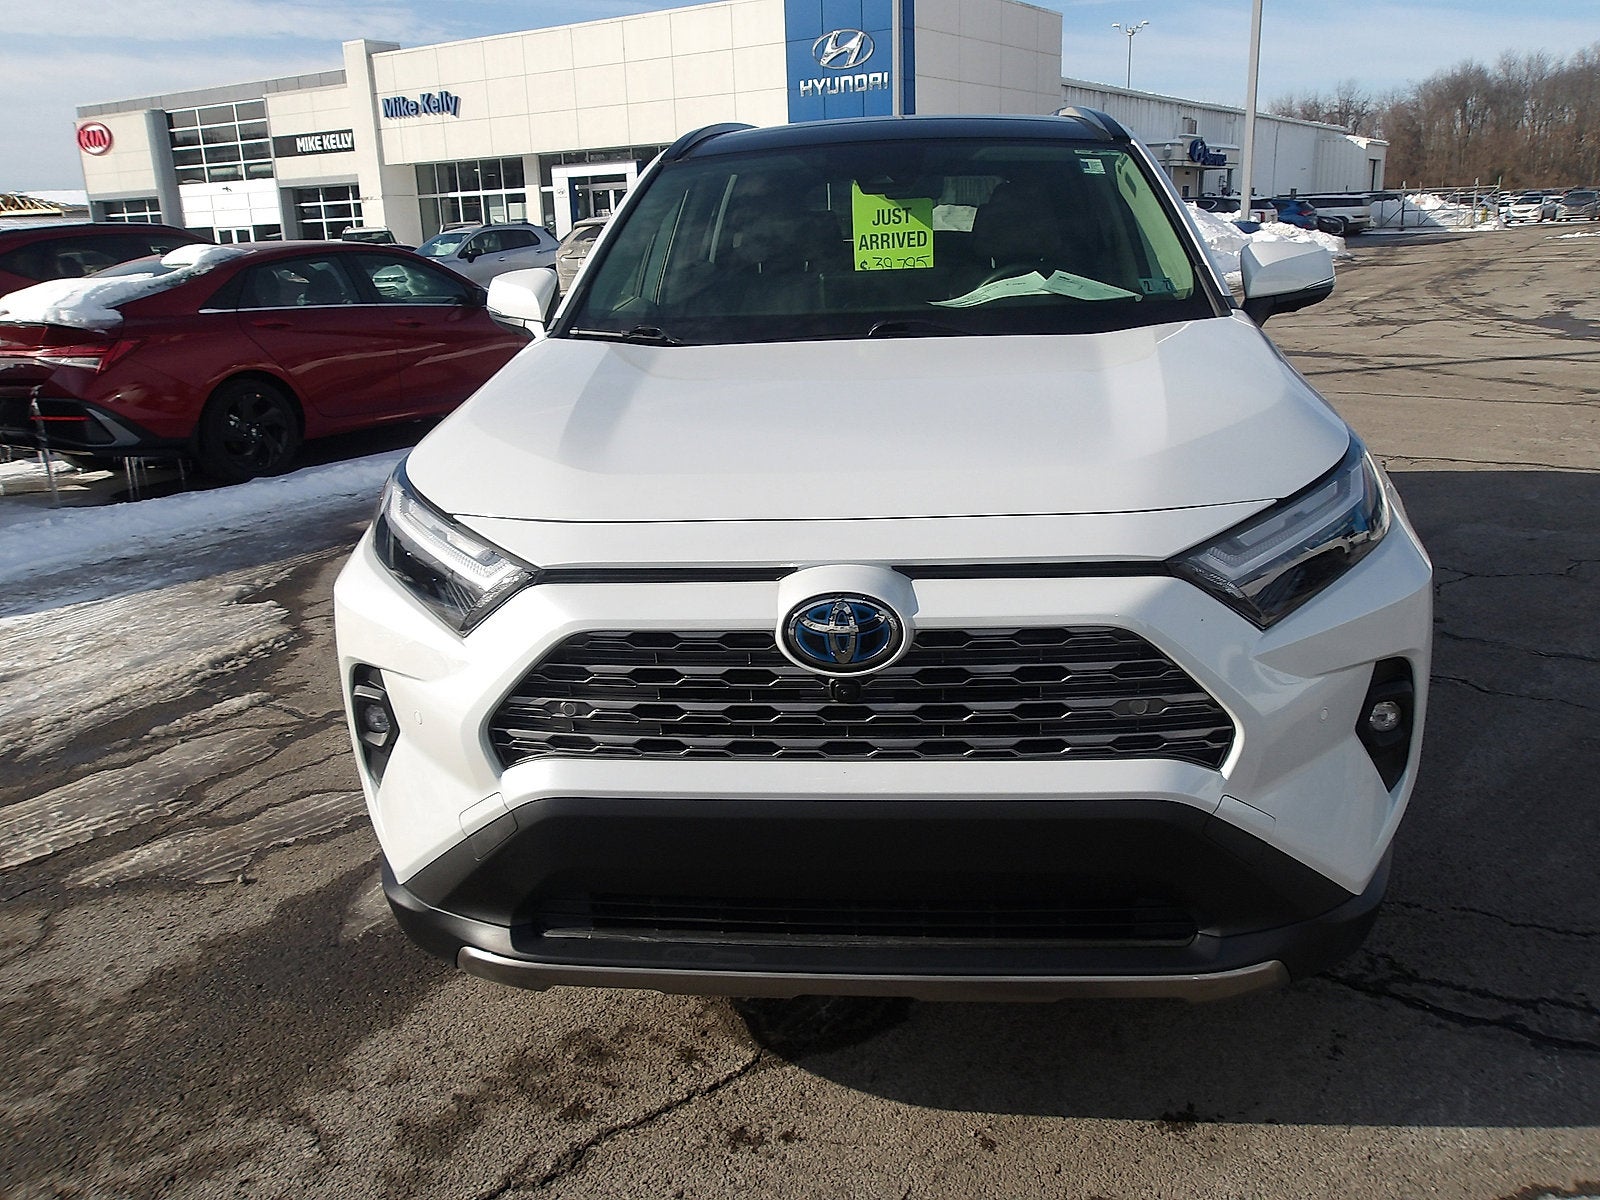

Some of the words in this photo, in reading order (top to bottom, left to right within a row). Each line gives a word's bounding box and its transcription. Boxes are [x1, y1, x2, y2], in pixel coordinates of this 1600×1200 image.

[800, 72, 889, 97] HYUNDAI
[382, 96, 420, 119] Mike
[420, 91, 461, 117] Kelly
[80, 130, 108, 149] KIA
[296, 136, 322, 152] MIKE
[322, 133, 352, 150] KELLY
[872, 207, 911, 226] JUST
[859, 231, 927, 250] ARRIVED
